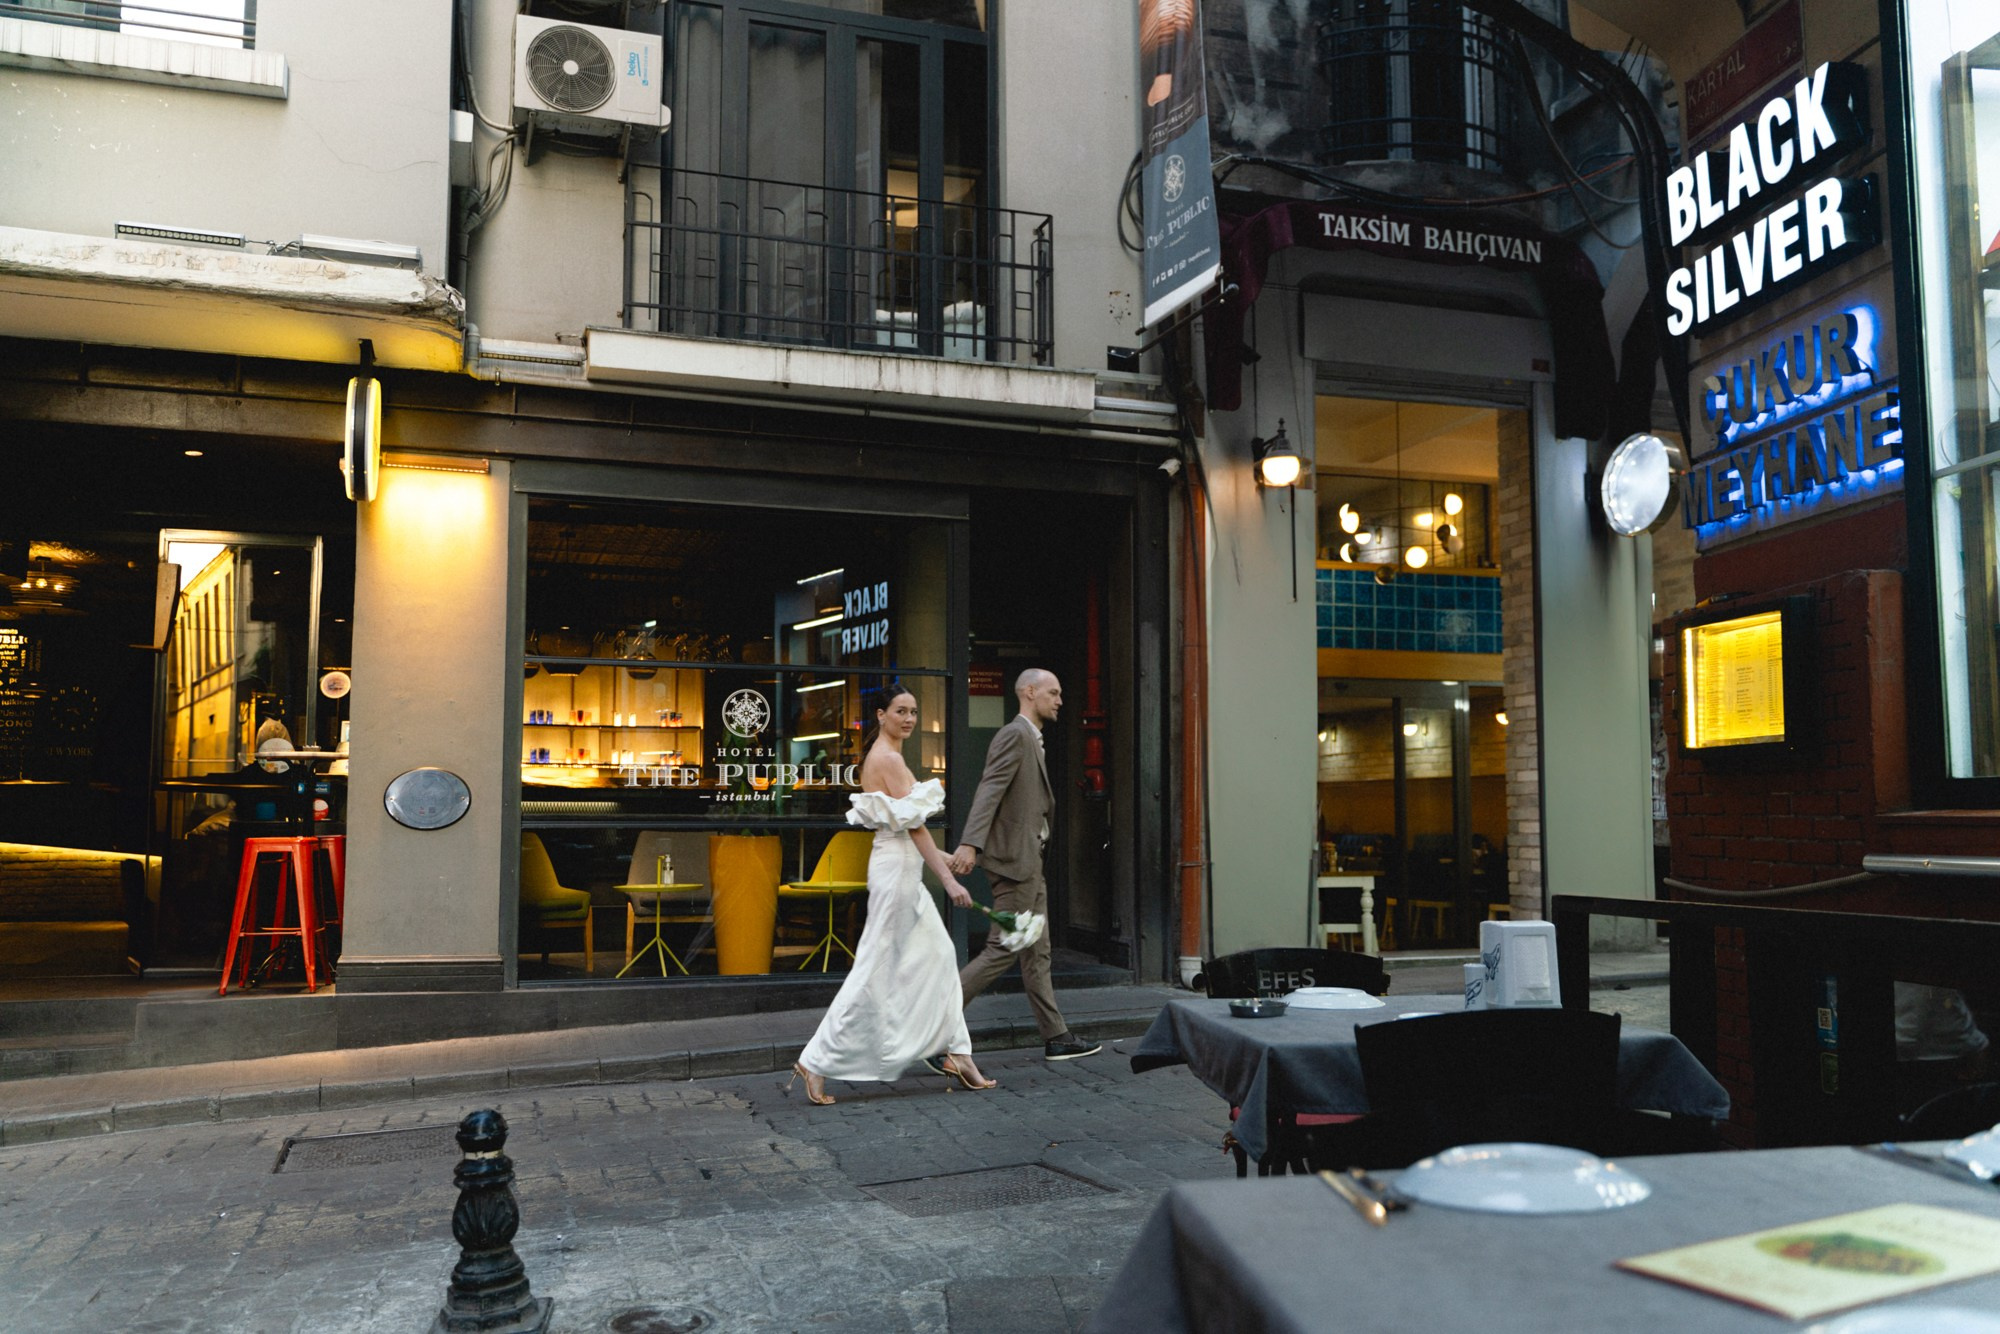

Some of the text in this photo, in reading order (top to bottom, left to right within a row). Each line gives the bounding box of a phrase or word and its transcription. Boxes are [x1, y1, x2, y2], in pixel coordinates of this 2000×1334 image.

[627, 52, 636, 76] beko
[1687, 50, 1745, 109] KARTAL
[1666, 61, 1837, 247] BLACK
[1166, 196, 1211, 236] PUBLIC
[1318, 212, 1542, 263] TAKSİM BAHÇIVAN
[1666, 176, 1848, 337] SILVER
[1700, 313, 1856, 450] ÇUKUR
[1679, 391, 1897, 529] MEYHANE
[618, 763, 699, 787] THE
[717, 748, 776, 757] HOTEL
[715, 790, 776, 802] istanbul
[1258, 968, 1317, 989] EFES
